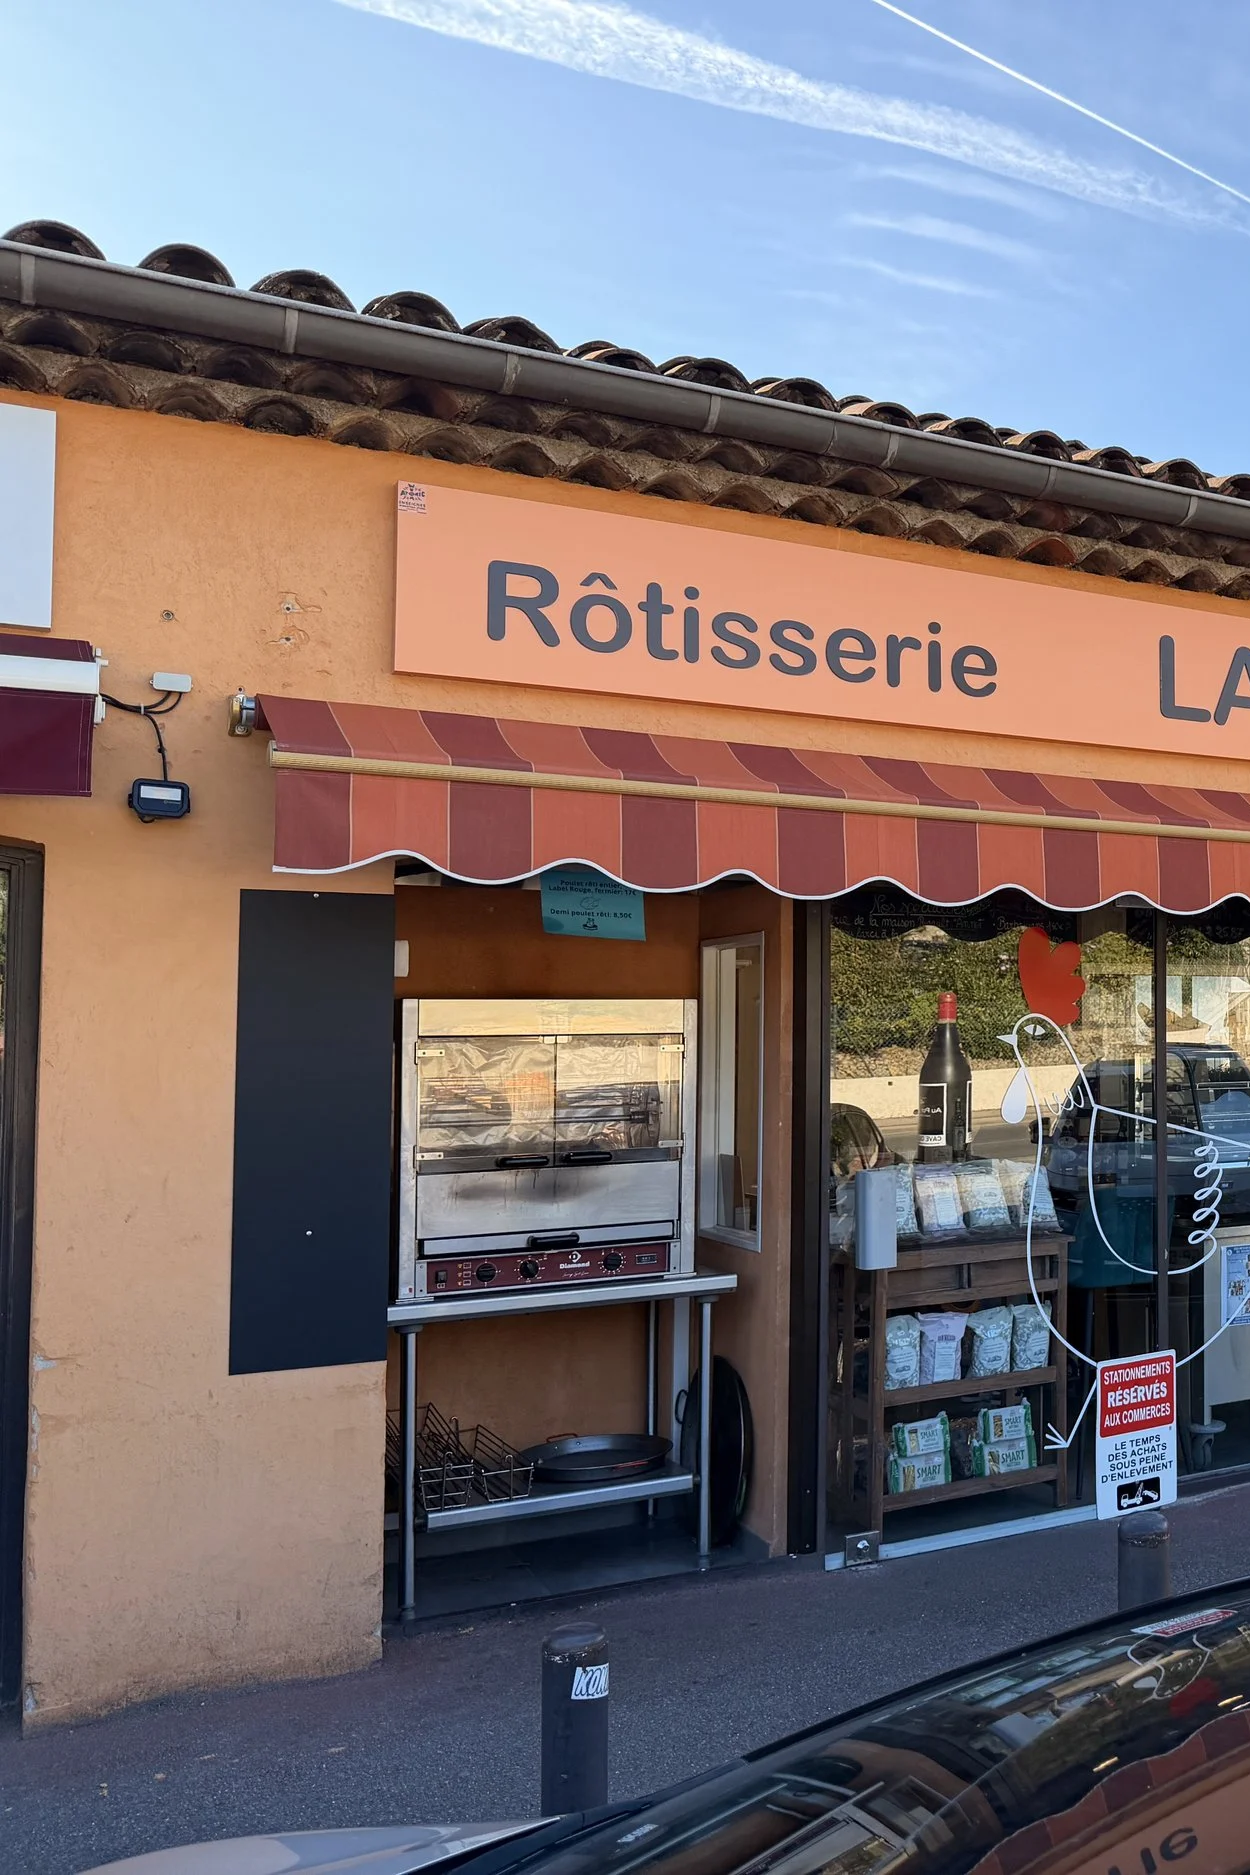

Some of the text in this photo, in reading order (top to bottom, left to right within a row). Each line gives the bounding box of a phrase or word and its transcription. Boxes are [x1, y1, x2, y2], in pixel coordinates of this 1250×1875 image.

[487, 560, 998, 698] Rôtisserie
[559, 1261, 591, 1269] Diamond
[1103, 1360, 1171, 1386] STATIONNEMENTS
[1107, 1379, 1168, 1408] RÉSERVÉS
[1004, 1415, 1022, 1426] SMART
[1104, 1402, 1171, 1428] AUX COMMERCES
[920, 1430, 939, 1440] SMART
[1114, 1434, 1161, 1451] LE TEMPS
[1001, 1450, 1026, 1464] SMART
[1107, 1442, 1168, 1463] DES ACHATS
[917, 1464, 943, 1479] SMART
[1101, 1460, 1173, 1484] D'ENLEVEMENT
[1109, 1453, 1167, 1472] SOUS PEINE
